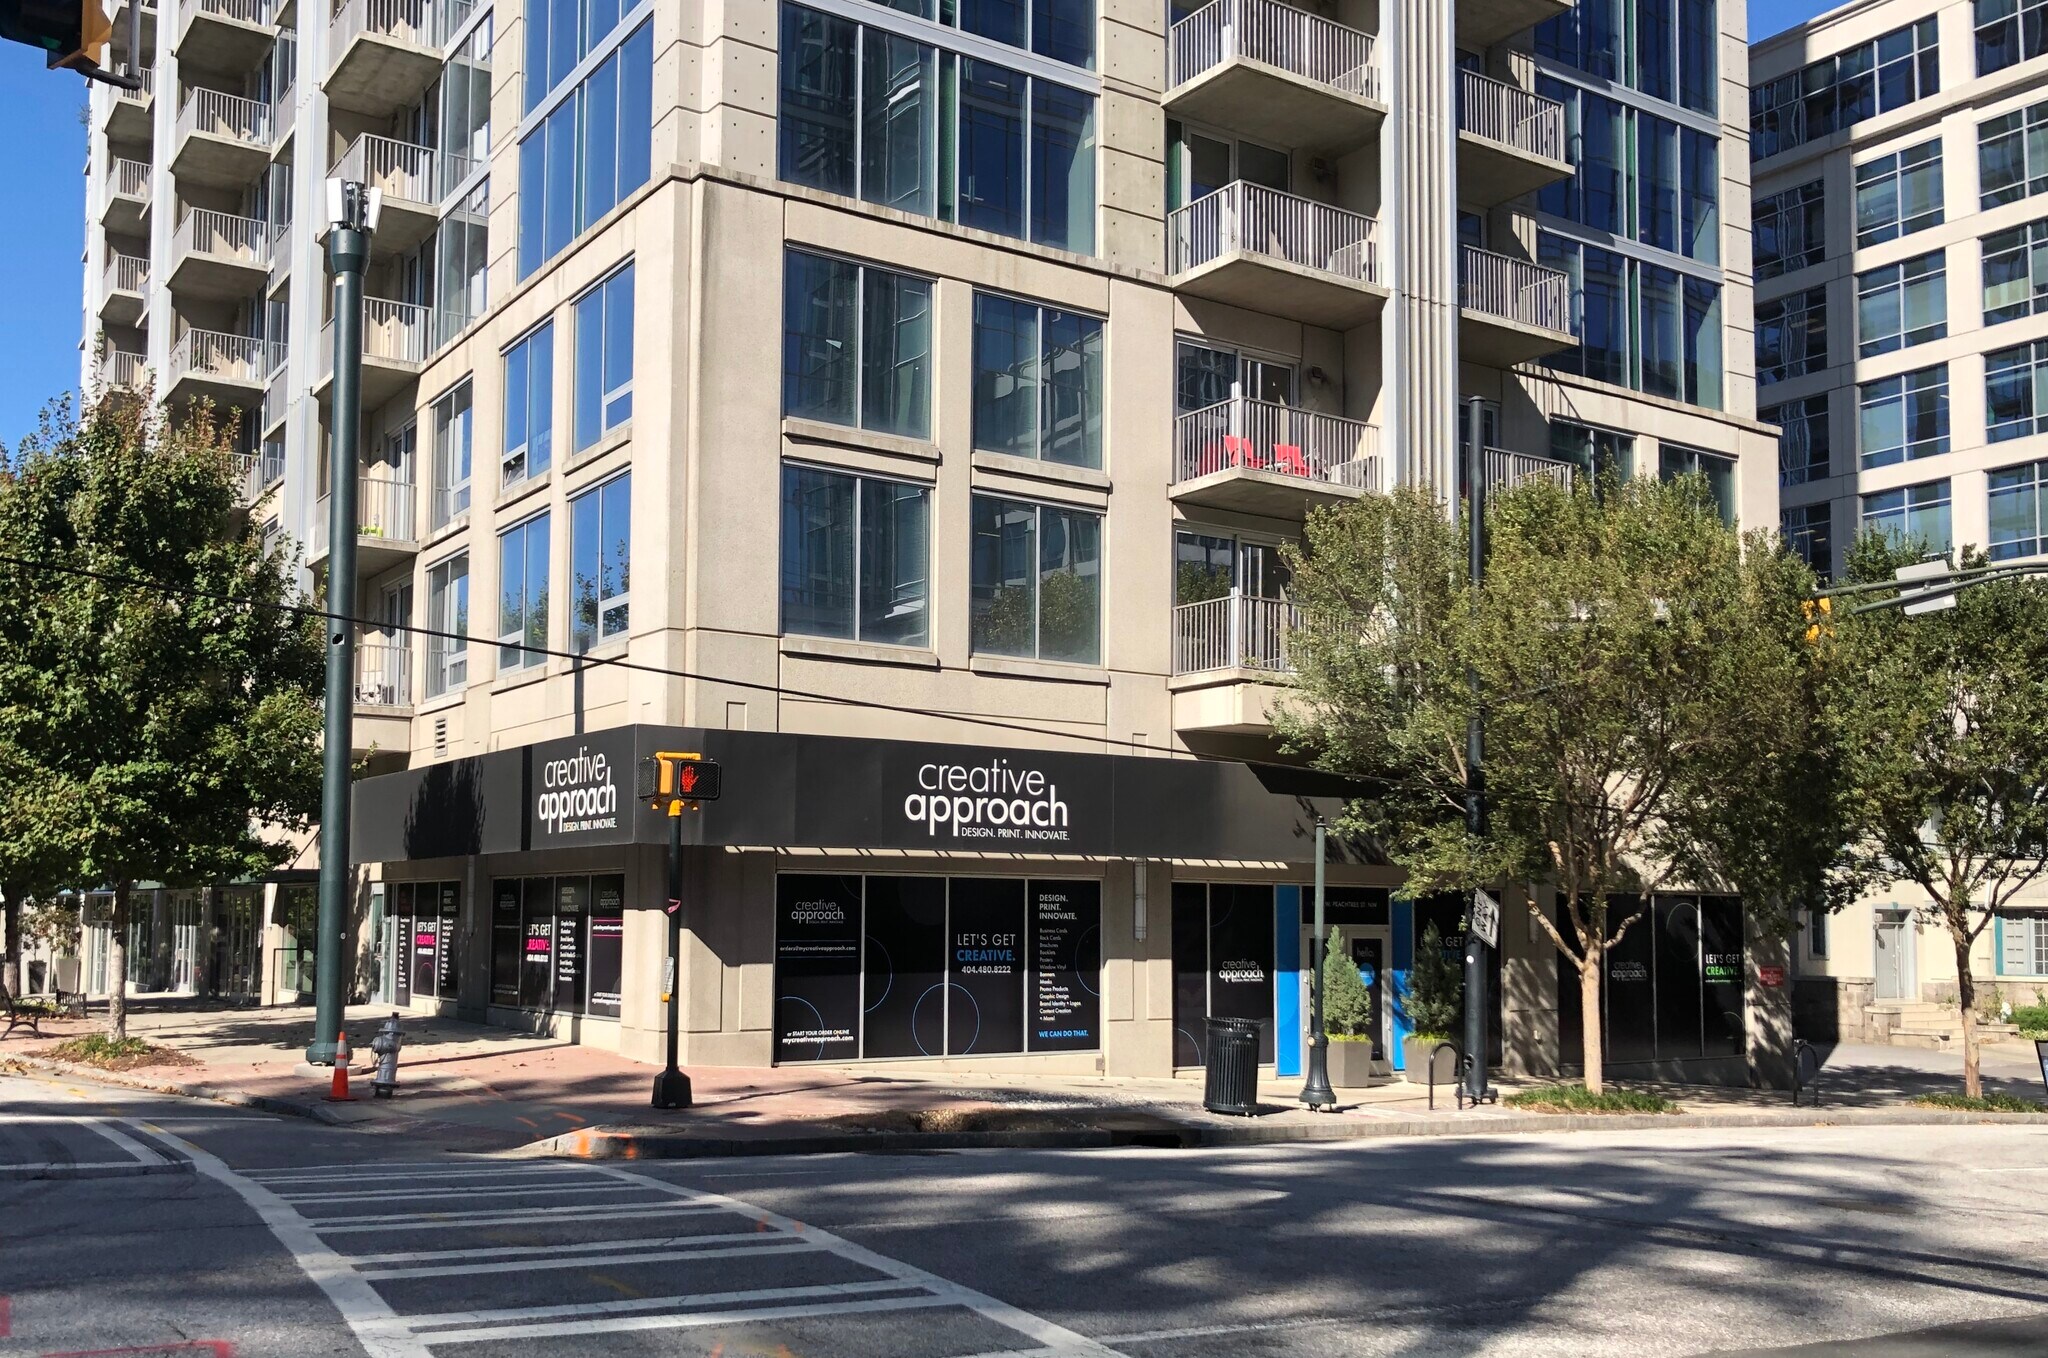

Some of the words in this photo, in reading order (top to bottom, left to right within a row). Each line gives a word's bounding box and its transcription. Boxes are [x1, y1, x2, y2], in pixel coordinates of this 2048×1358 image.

[545, 746, 606, 788] creative
[918, 758, 1045, 796] creative
[538, 766, 617, 834] approach
[904, 784, 1068, 837] approach
[961, 827, 996, 838] DESIGN.
[997, 828, 1023, 839] PRINT.
[1024, 830, 1070, 841] INNOVATE.
[1039, 894, 1069, 902] DESIGN.
[795, 899, 837, 911] creative
[1039, 903, 1062, 911] PRINT.
[791, 906, 844, 924] approach
[1039, 912, 1078, 920] INNOVATE.
[540, 923, 552, 936] GET
[957, 933, 988, 946] LET'S
[992, 933, 1016, 946] GET
[1445, 936, 1464, 947] GET
[956, 949, 1016, 962] CREATIVE.
[1705, 953, 1724, 964] LET'S
[1725, 953, 1740, 964] GET
[961, 965, 1012, 974] 404.480.8222
[1222, 957, 1257, 970] creative
[1218, 964, 1264, 983] approach
[782, 1034, 854, 1045] mycreativeapproach.com
[1039, 1030, 1049, 1038] WE
[1049, 1030, 1062, 1038] CAN
[1073, 1029, 1089, 1037] THAT.
